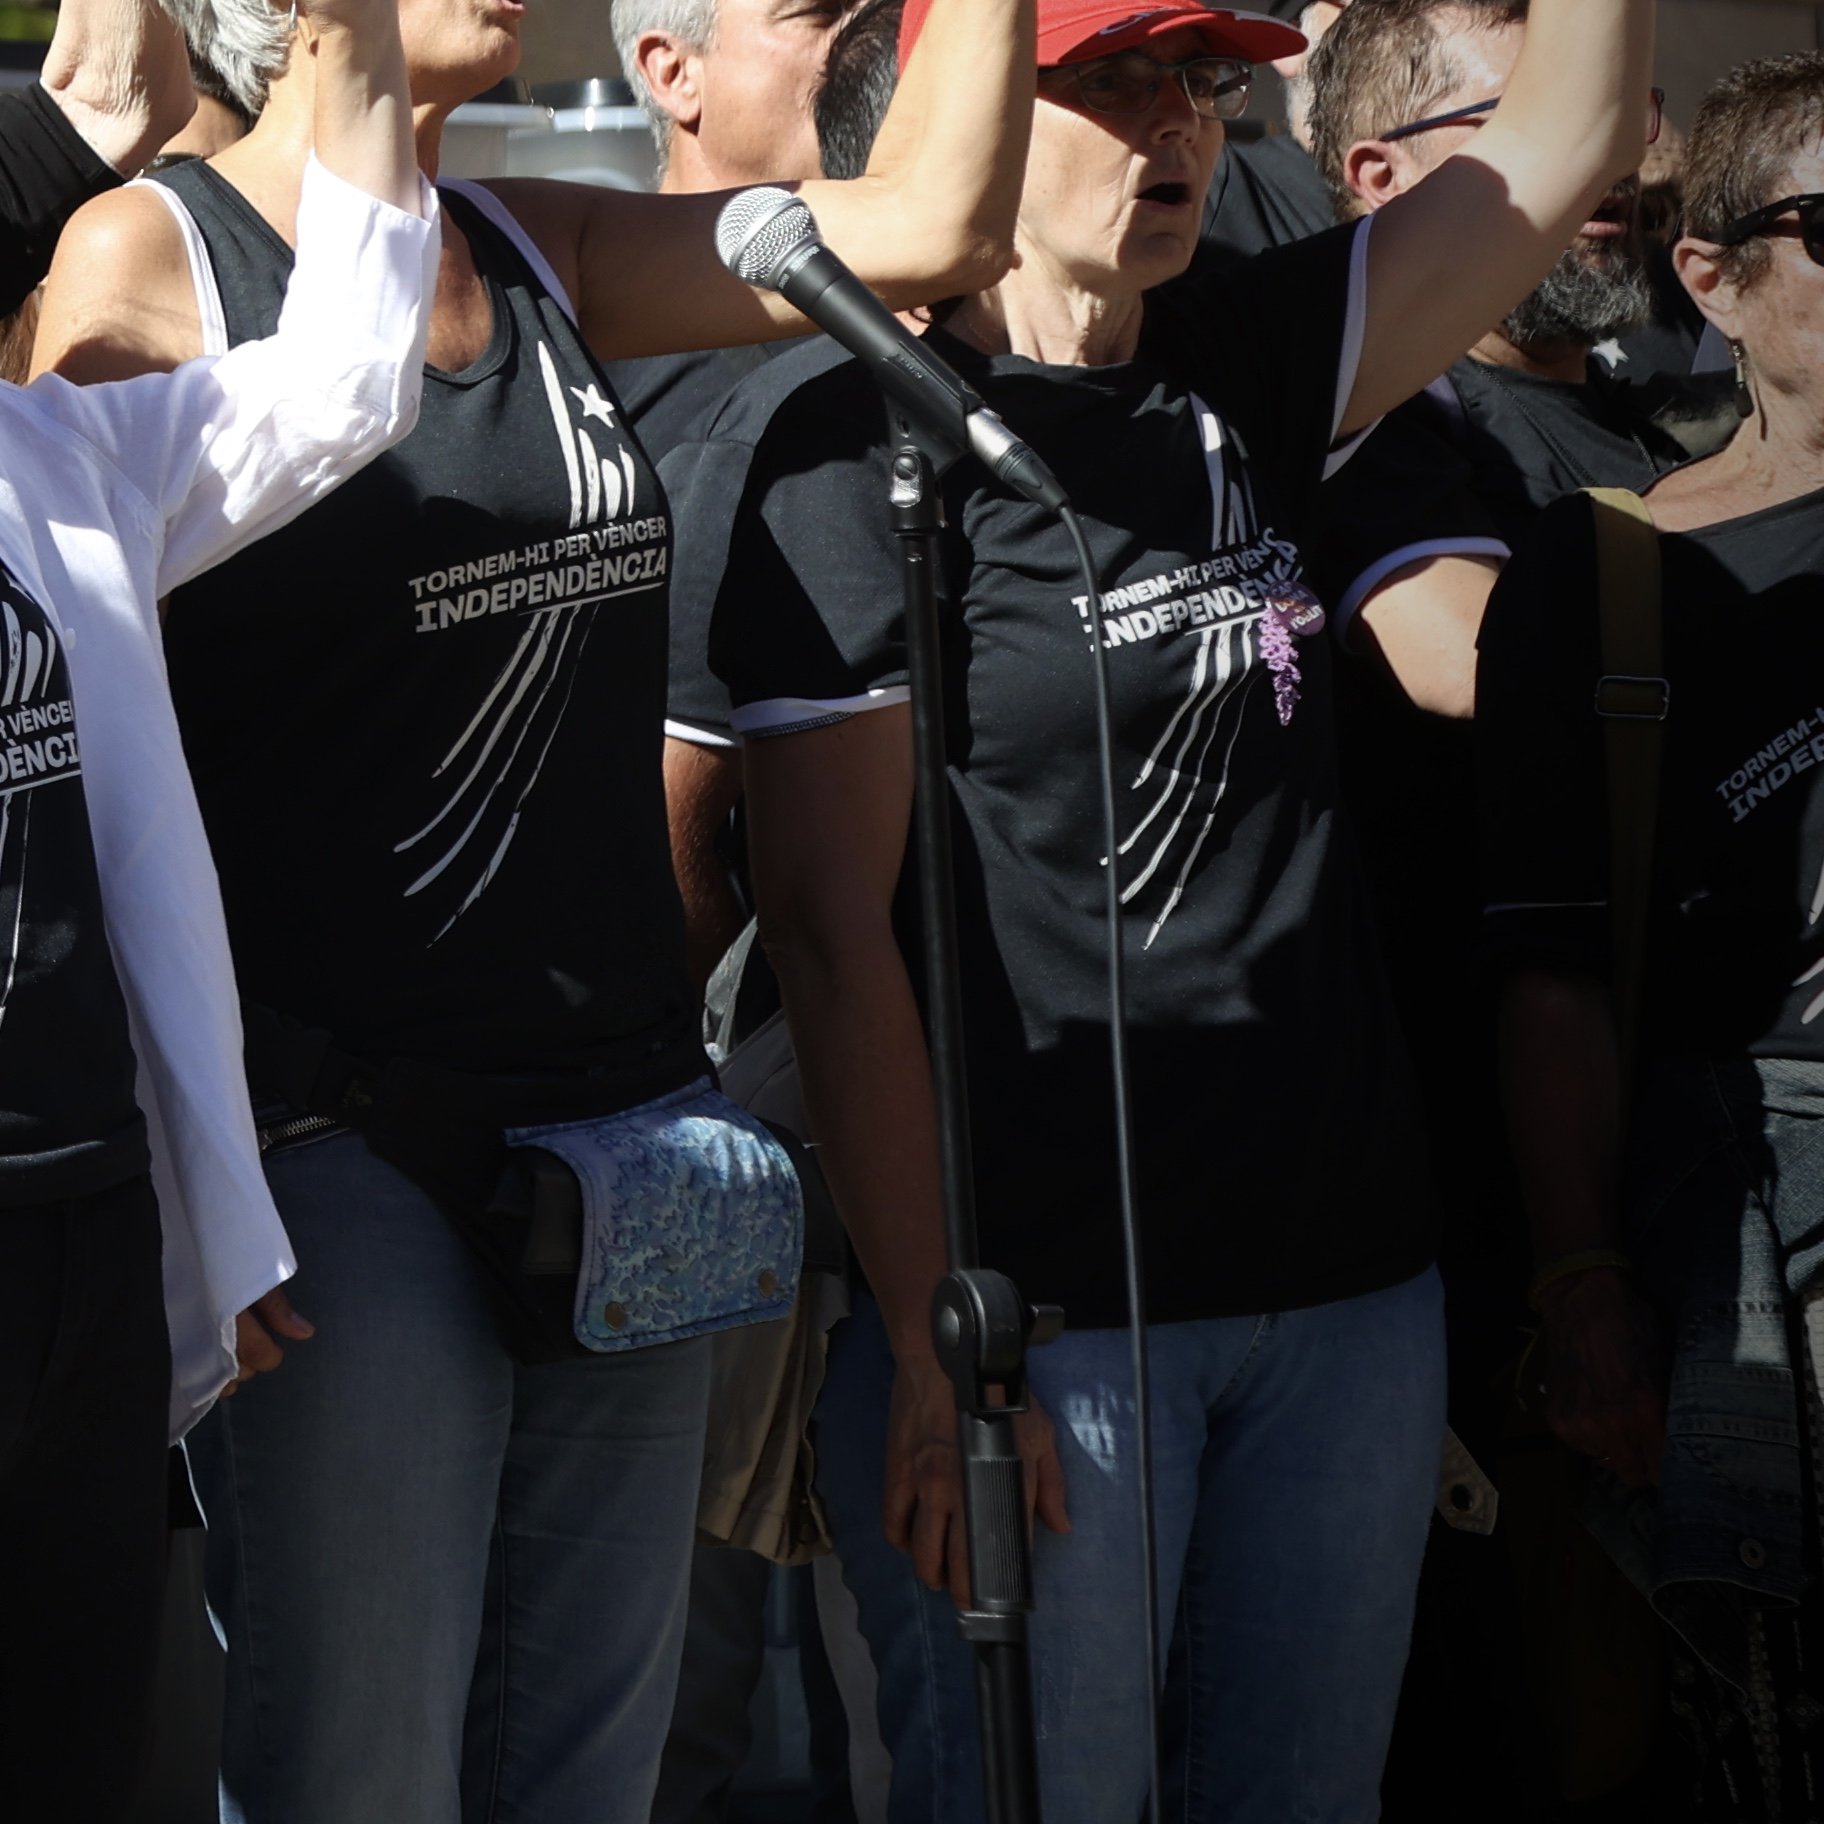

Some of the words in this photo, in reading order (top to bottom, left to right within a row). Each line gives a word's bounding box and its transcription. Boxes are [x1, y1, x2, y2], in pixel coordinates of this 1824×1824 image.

[409, 542, 550, 599] TORNEM-HI
[554, 533, 592, 561] PER
[593, 516, 667, 551] VÈNCER
[415, 547, 667, 633] INDEPENDÈNCIA
[7, 700, 73, 738] VÈNCE
